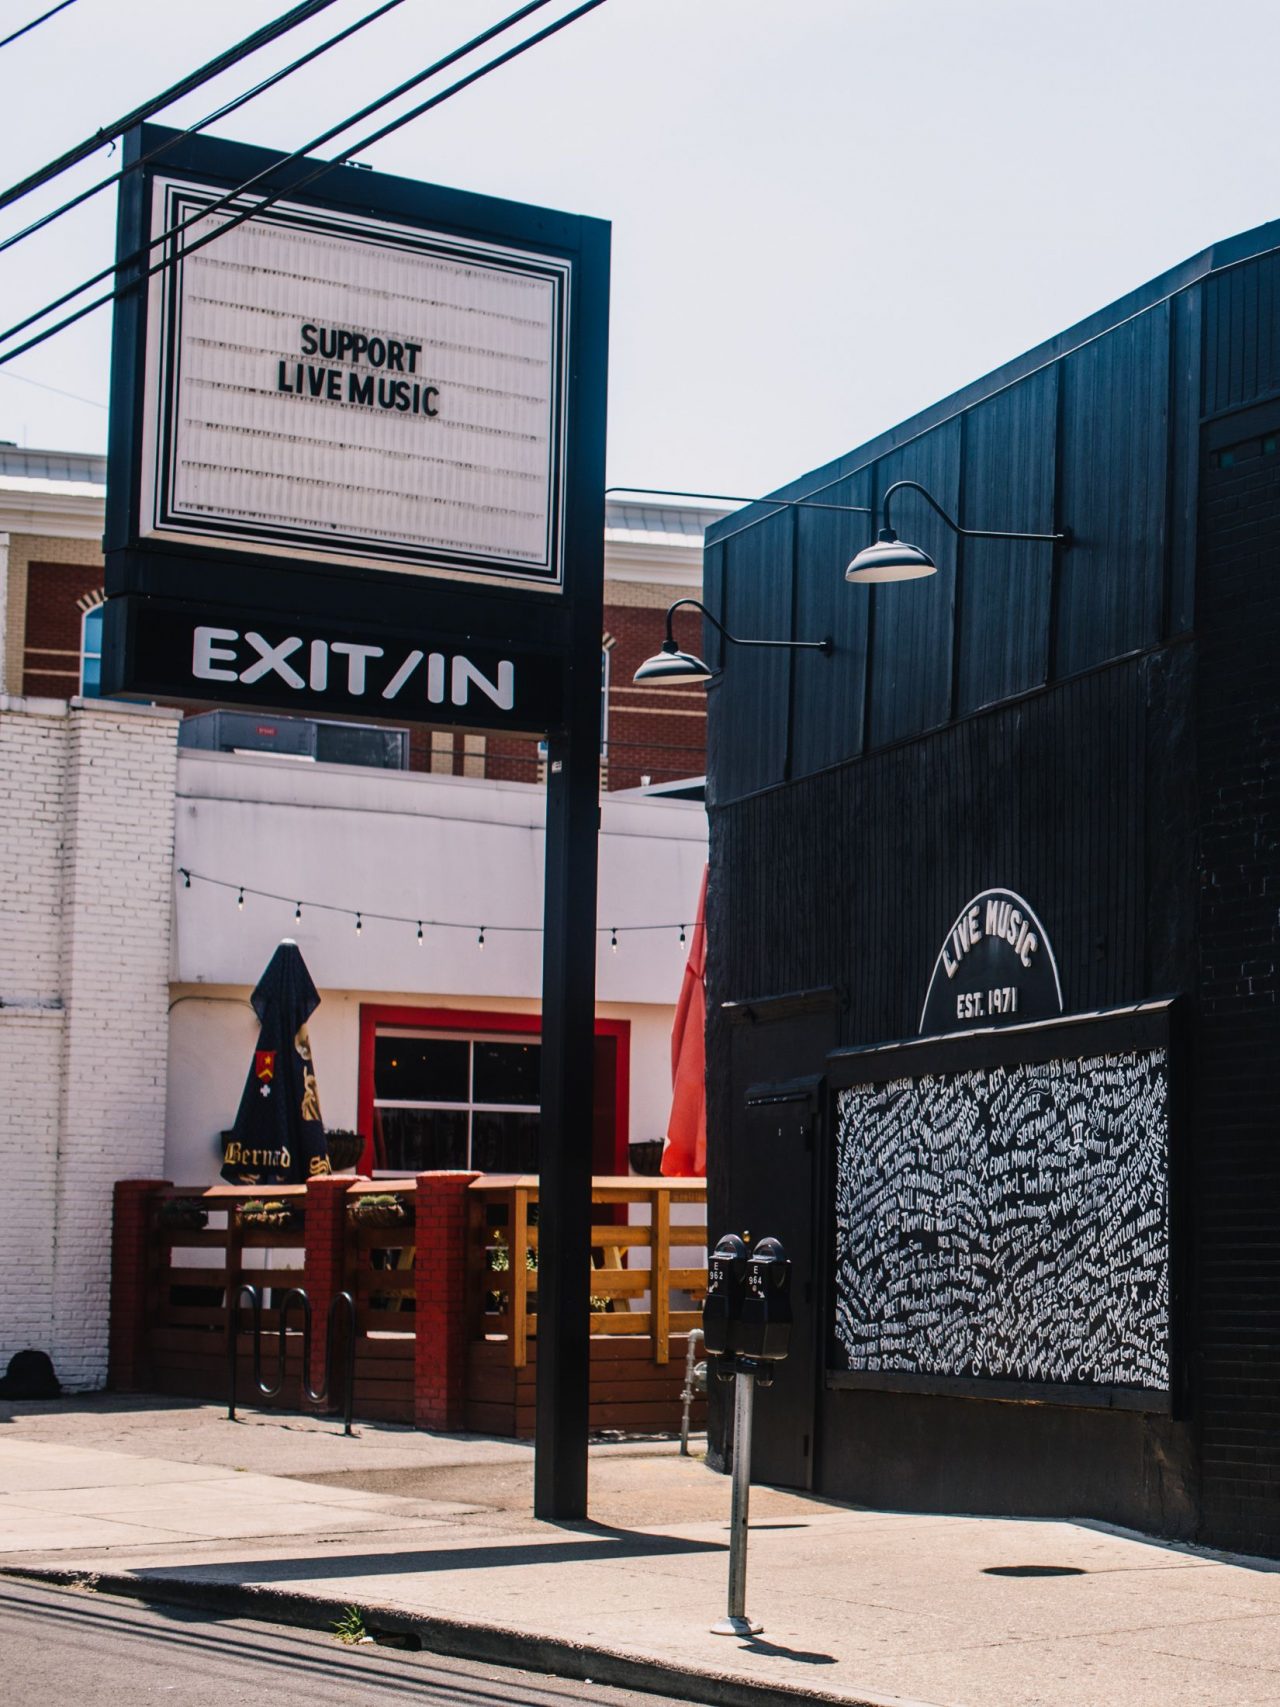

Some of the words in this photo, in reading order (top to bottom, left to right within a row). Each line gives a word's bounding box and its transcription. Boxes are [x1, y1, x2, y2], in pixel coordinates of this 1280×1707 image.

[301, 324, 422, 373] SUPPORT
[278, 361, 343, 401] LIVE
[348, 372, 439, 417] MUSIC
[192, 626, 514, 710] EXIT/IN
[942, 905, 982, 978] LIVE
[985, 900, 1037, 967] MUSIC
[957, 992, 984, 1019] EST.
[988, 986, 1018, 1014] 1971
[990, 1066, 1005, 1093] REM
[710, 1271, 723, 1280] 962
[714, 1262, 719, 1270] E
[749, 1276, 762, 1285] 964
[753, 1265, 758, 1274] E
